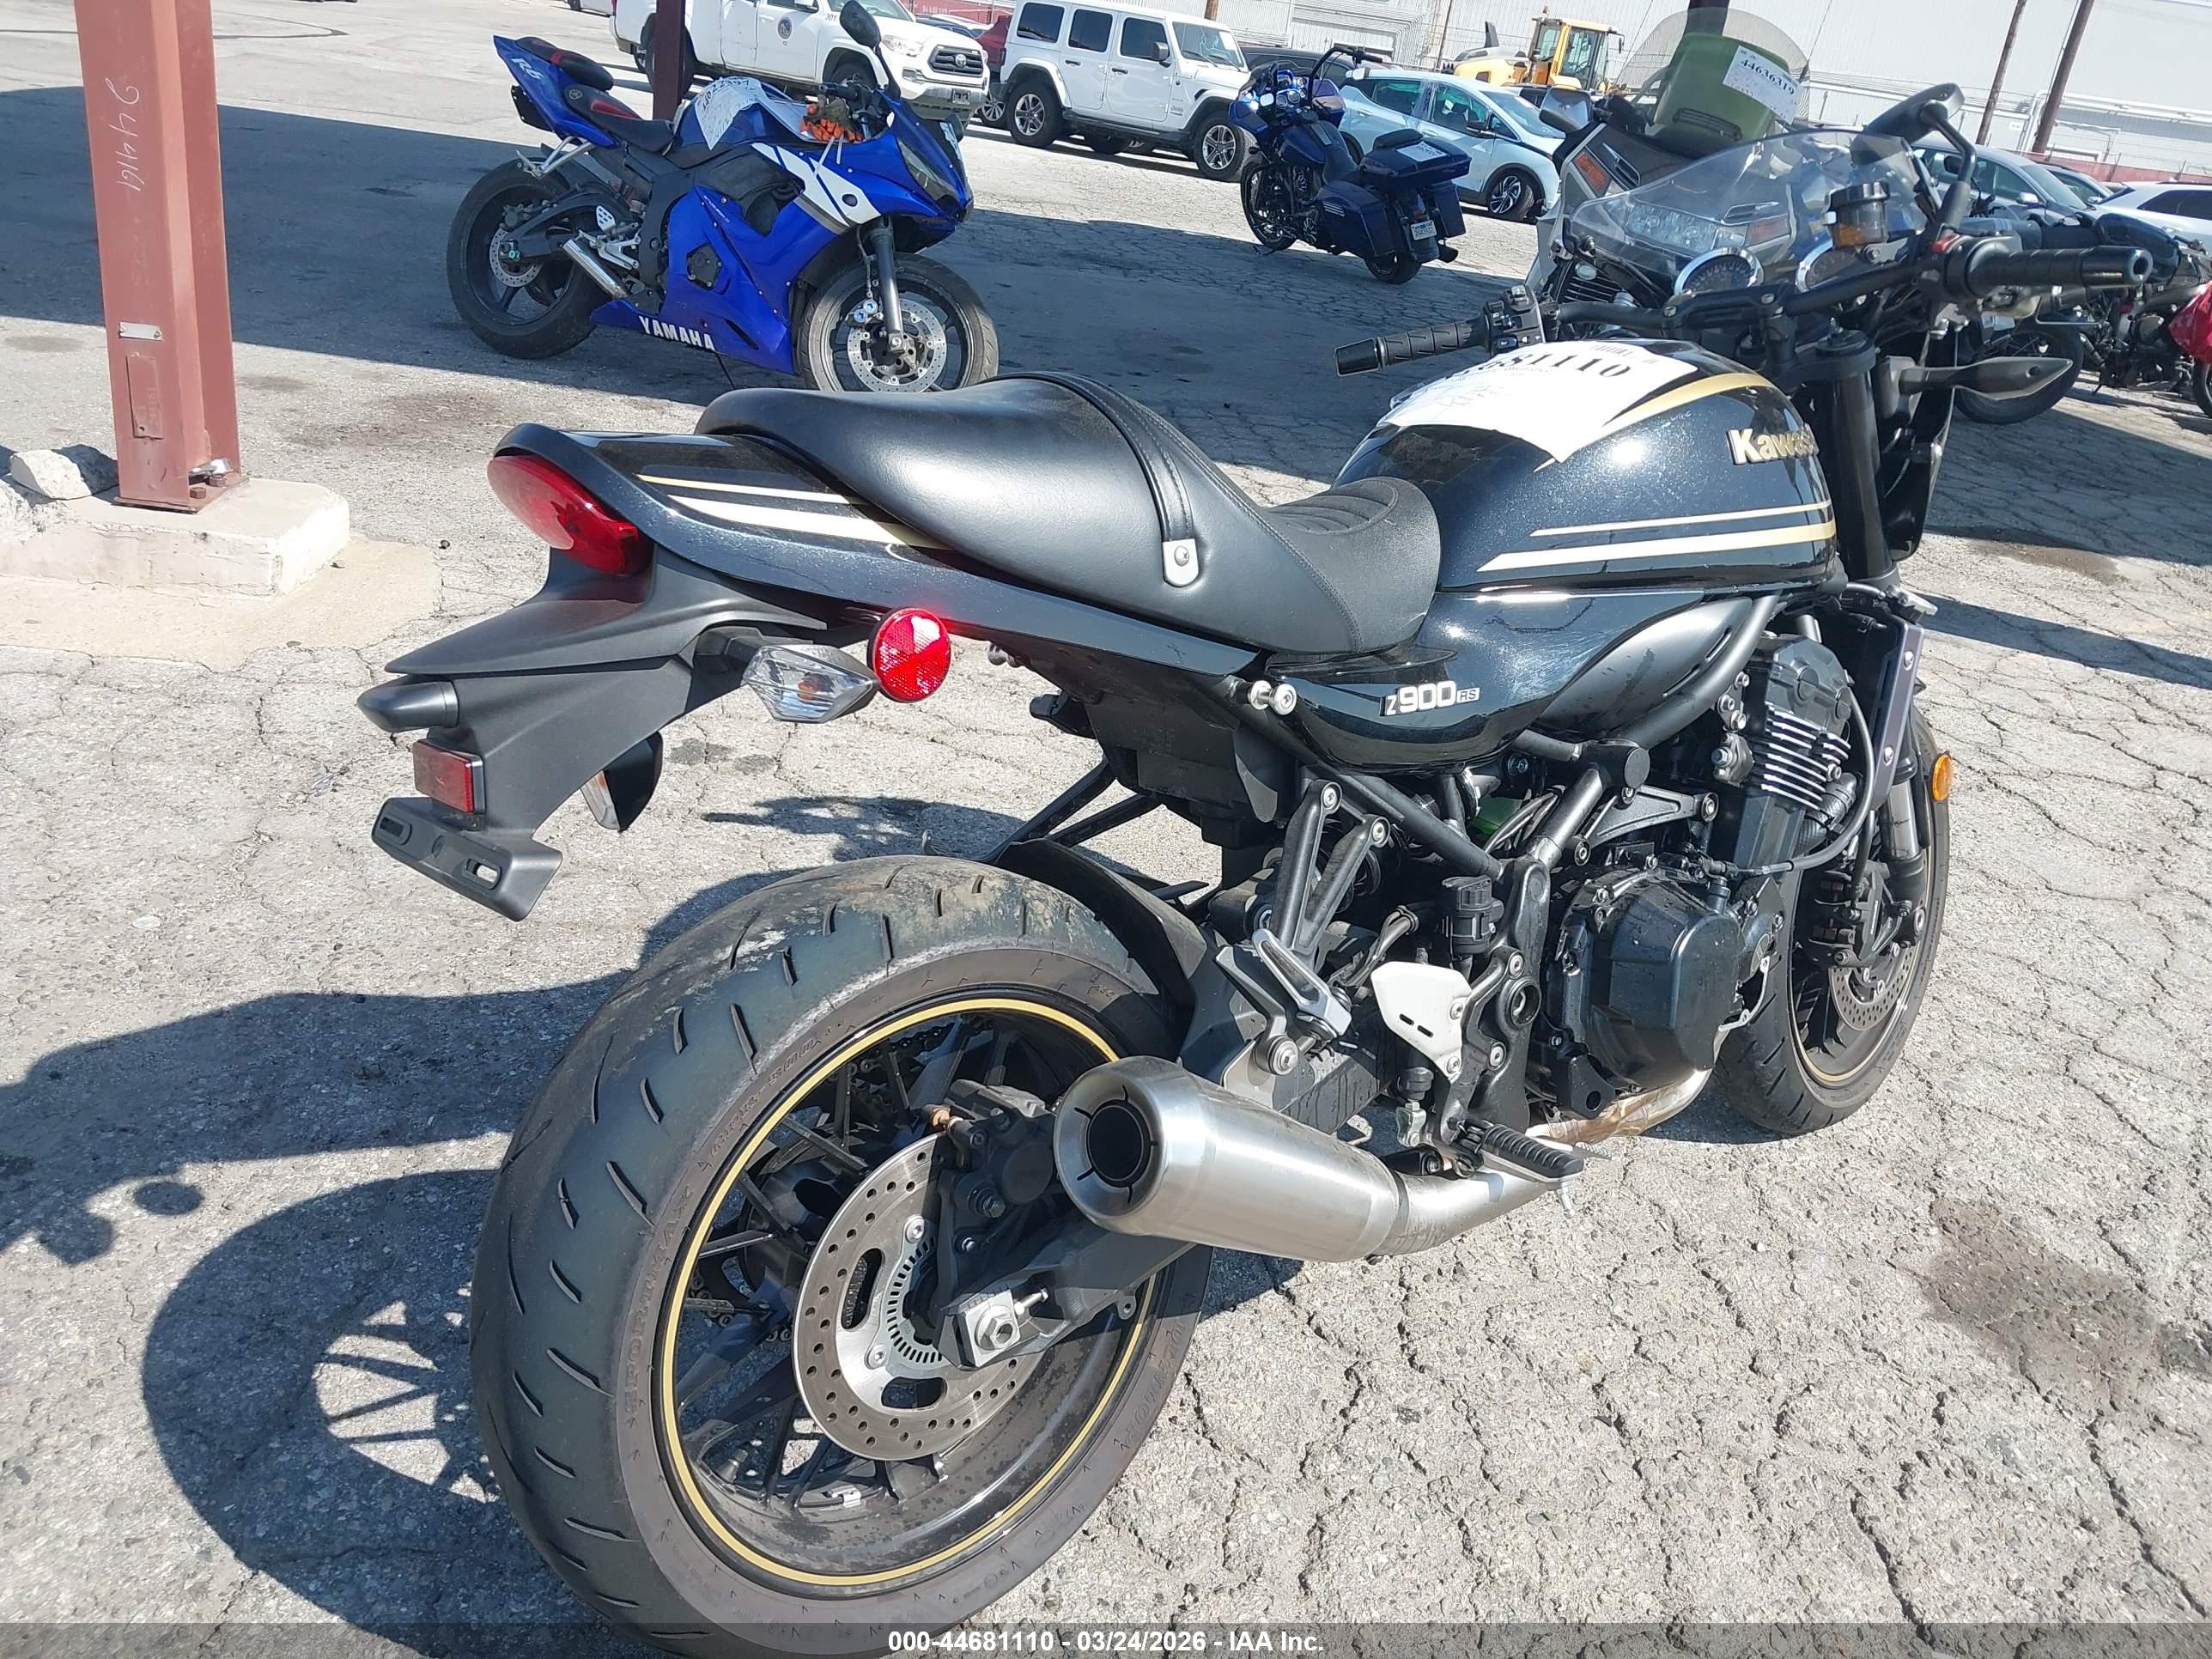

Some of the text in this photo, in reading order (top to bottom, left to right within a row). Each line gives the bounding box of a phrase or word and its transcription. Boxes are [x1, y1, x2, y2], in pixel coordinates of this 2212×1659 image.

[511, 58, 544, 80] R6
[1741, 59, 1796, 95] 44636319
[638, 315, 716, 352] YAMAHA
[1727, 428, 1817, 465] Kawa
[1379, 680, 1456, 716] Z900
